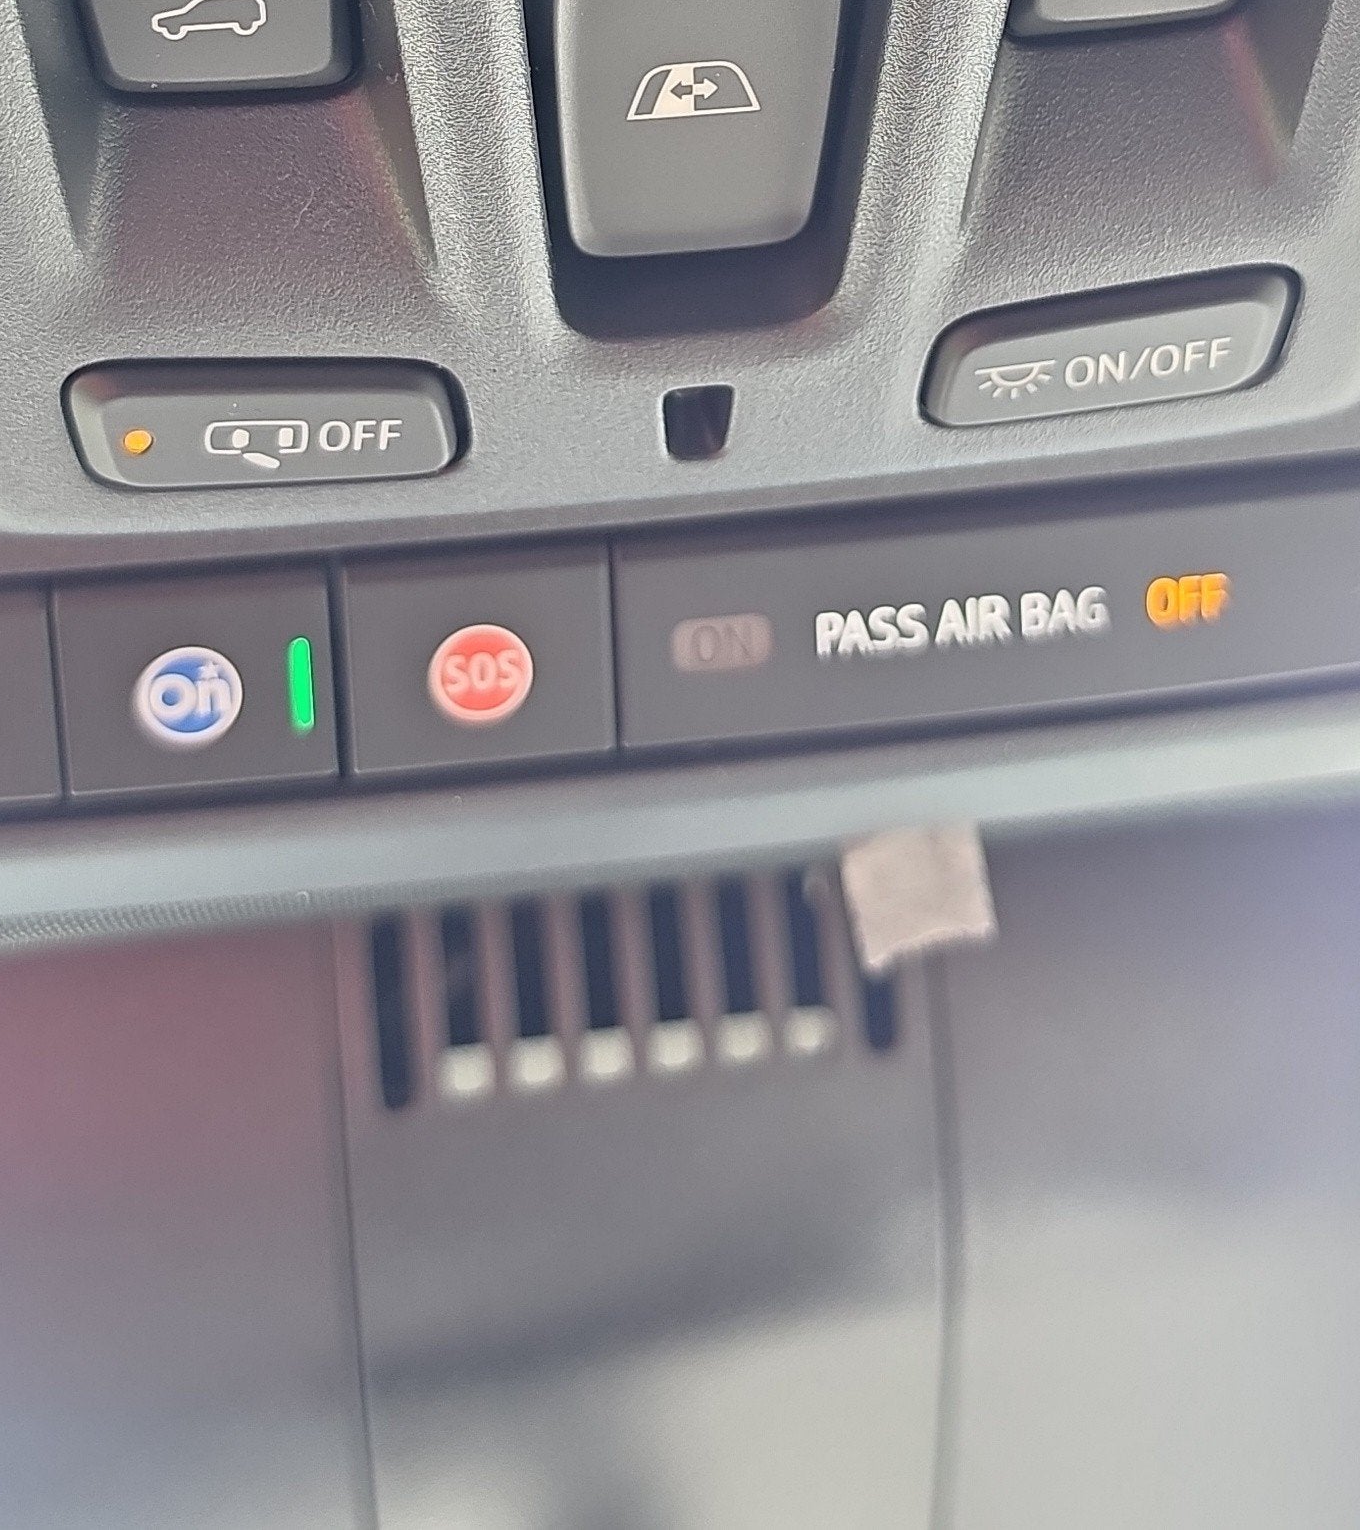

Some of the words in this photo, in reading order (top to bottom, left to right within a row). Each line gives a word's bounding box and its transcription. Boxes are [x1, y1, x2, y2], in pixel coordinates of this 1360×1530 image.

[1064, 336, 1233, 391] ON/OFF
[319, 419, 403, 452] OFF
[691, 622, 754, 666] ON
[815, 602, 930, 659] PASS
[935, 595, 1013, 648] AIR
[1021, 586, 1111, 638] BAG
[1145, 572, 1230, 630] OFF
[444, 649, 521, 693] SOS
